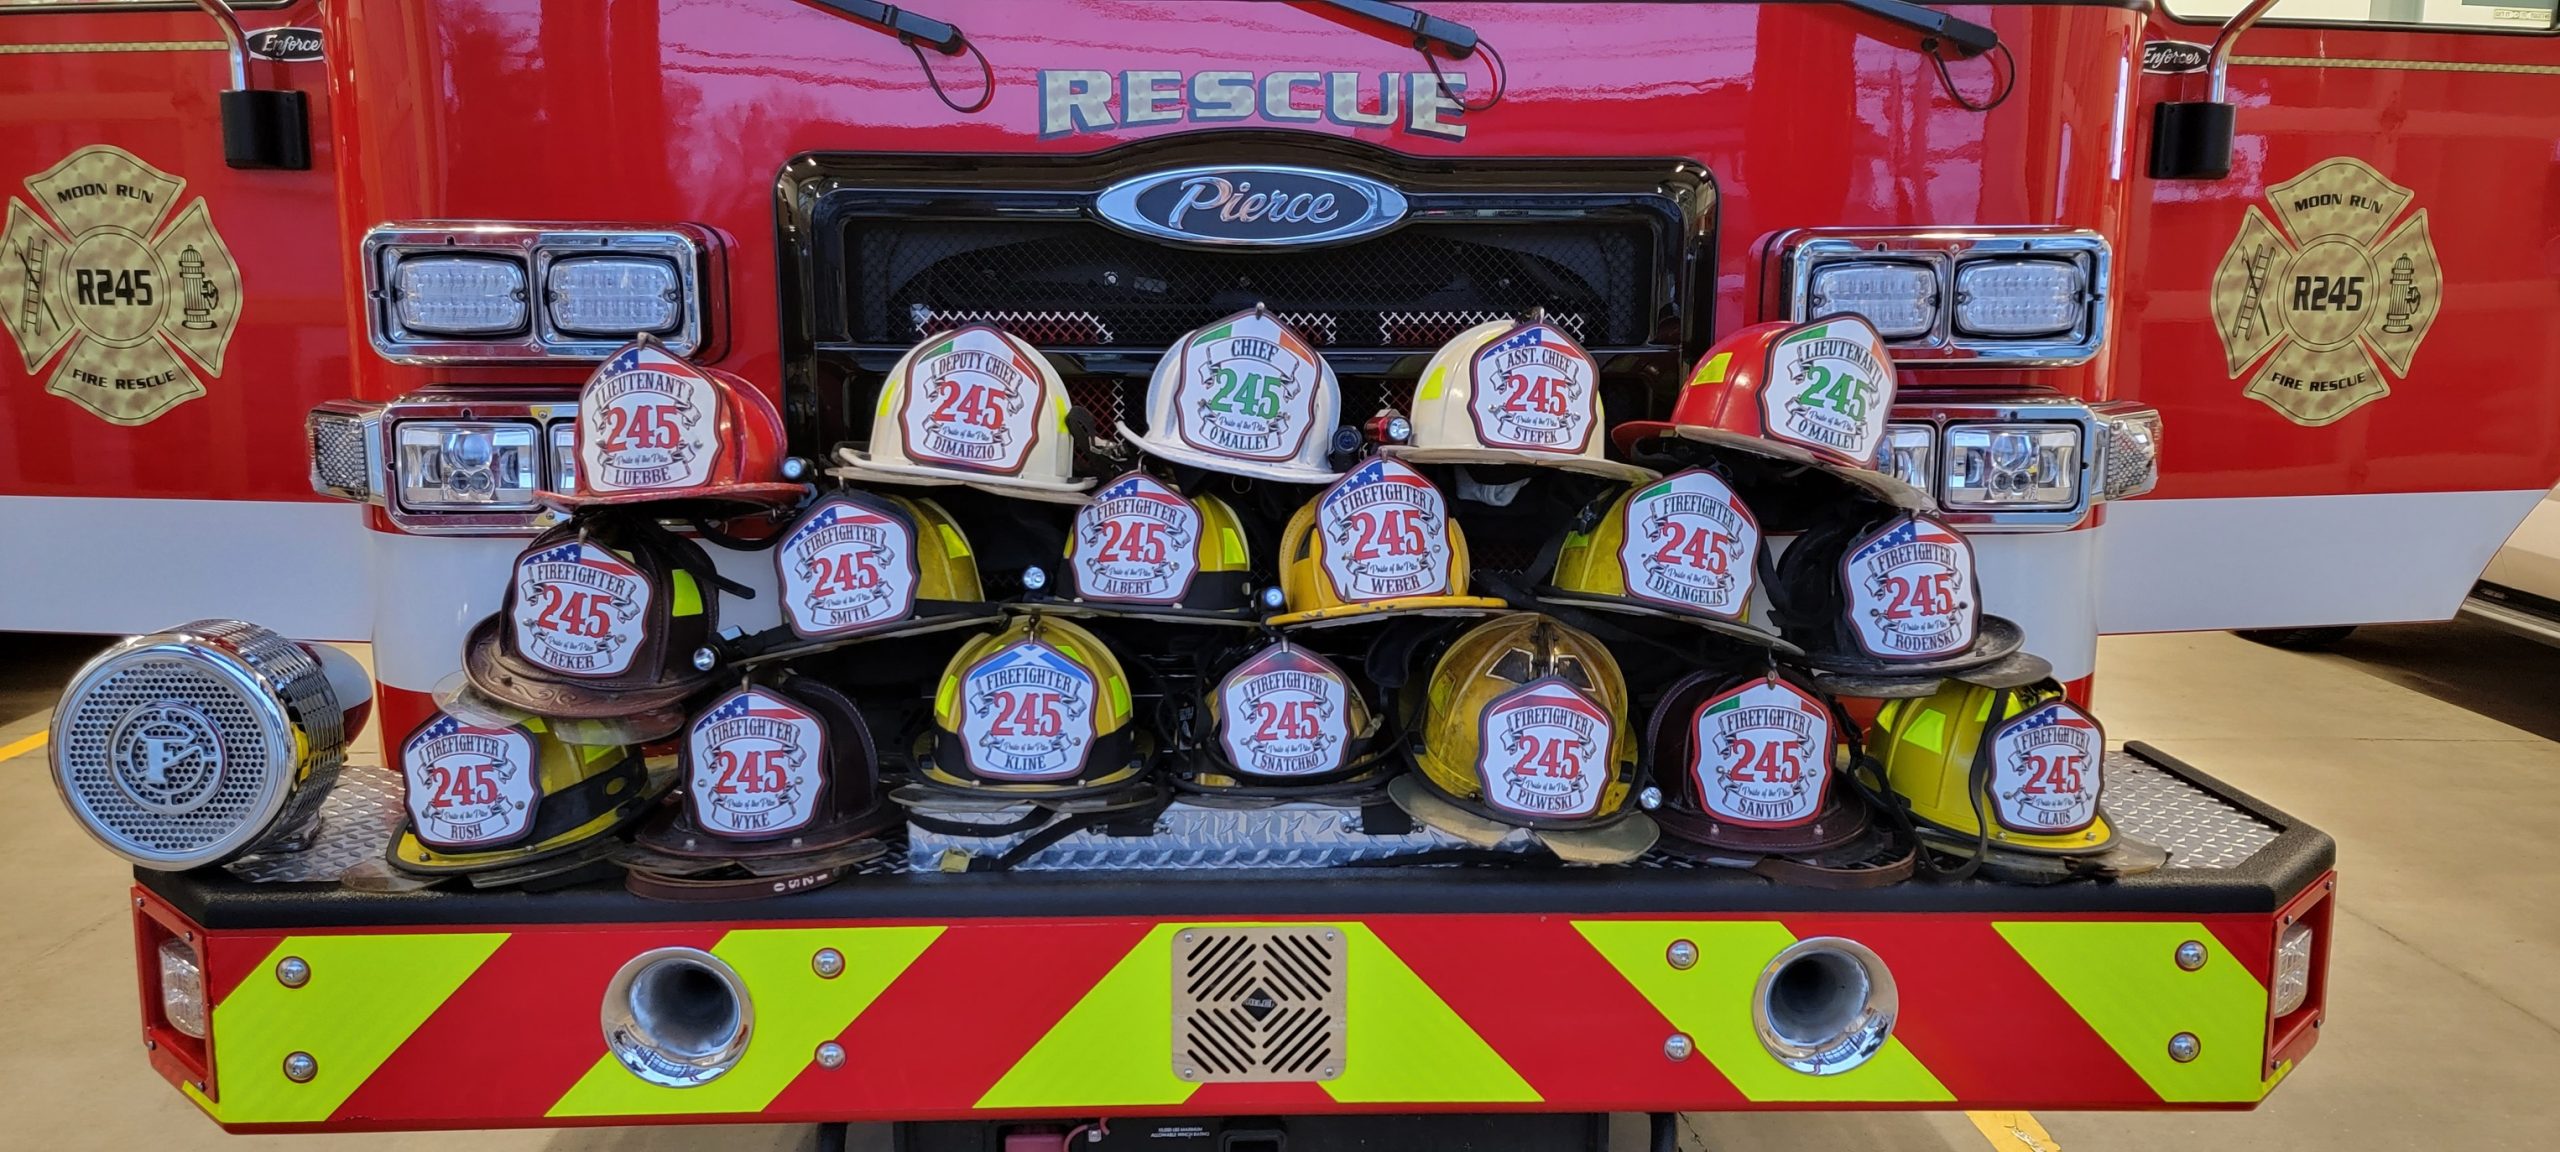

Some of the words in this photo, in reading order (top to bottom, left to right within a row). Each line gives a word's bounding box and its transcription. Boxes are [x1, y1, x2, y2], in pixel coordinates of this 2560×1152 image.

[2143, 47, 2202, 69] Enforcer
[1038, 69, 1468, 142] RESCUE
[57, 182, 108, 204] MOON
[116, 183, 154, 204] RUN
[1168, 176, 1339, 230] Pierce
[2294, 193, 2343, 212] MOON
[2349, 193, 2384, 214] RUN
[76, 269, 153, 306] R245
[2292, 276, 2365, 312] R245
[1231, 339, 1279, 362] CHIEF
[1507, 348, 1539, 367] ASST.
[1542, 349, 1571, 373] CHIEF
[1805, 340, 1878, 380] LIEUTENANT
[72, 368, 108, 388] FIRE
[115, 369, 176, 390] RESCUE
[939, 353, 984, 374] DEPUTY
[986, 357, 1017, 386] CHIEF
[2272, 371, 2304, 391] FIRE
[2309, 371, 2367, 392] RESCUE
[602, 372, 685, 400] LIEUTENANT
[1210, 368, 1282, 419] 245
[1505, 374, 1568, 416] 245
[1799, 366, 1870, 421] 245
[933, 380, 1007, 430] 245
[605, 405, 681, 452] 245
[1210, 427, 1269, 449] O'MALLEY
[1514, 427, 1557, 443] STEPEK
[1799, 421, 1856, 448] O'MALLEY
[933, 436, 994, 458] DIMARZIO
[615, 467, 671, 485] LUEBBE
[1097, 499, 1177, 524] FIREFIGHTER
[1341, 484, 1426, 514] FIREFIGHTER
[1664, 495, 1735, 531] FIREFIGHTER
[804, 526, 877, 555] FIREFIGHTER
[1098, 521, 1167, 564] 245
[1351, 510, 1425, 560] 245
[1658, 522, 1729, 575] 245
[1877, 543, 1951, 572] FIREFIGHTER
[538, 565, 626, 596] FIREFIGHTER
[811, 551, 879, 598] 245
[1104, 580, 1152, 595] ALBERT
[1371, 575, 1421, 593] WEBER
[1655, 577, 1723, 604] DEANGELIS
[1885, 573, 1953, 620] 245
[537, 585, 612, 638] 245
[830, 606, 871, 625] SMITH
[1895, 631, 1955, 650] RODENSKI
[543, 648, 594, 669] FREKER
[986, 668, 1072, 692] FIREFIGHTER
[1250, 672, 1322, 697] FIREFIGHTER
[991, 691, 1062, 737] 245
[1256, 701, 1319, 741] 245
[1514, 707, 1588, 735] FIREFIGHTER
[1727, 709, 1805, 732] FIREFIGHTER
[712, 718, 793, 745] FIREFIGHTER
[2022, 727, 2086, 749] FIREFIGHTER
[426, 736, 499, 762] FIREFIGHTER
[1005, 755, 1046, 770] KLINE
[1261, 753, 1318, 771] SNATCHKO
[1515, 736, 1581, 779] 245
[1730, 739, 1801, 783] 245
[432, 764, 498, 807] 245
[716, 751, 787, 794] 245
[2024, 756, 2081, 794] 245
[1517, 789, 1573, 810] PILWESKI
[1738, 798, 1793, 817] SANVITO
[451, 823, 483, 839] RUSH
[732, 812, 770, 828] WYKE
[2038, 810, 2070, 825] CLAUS
